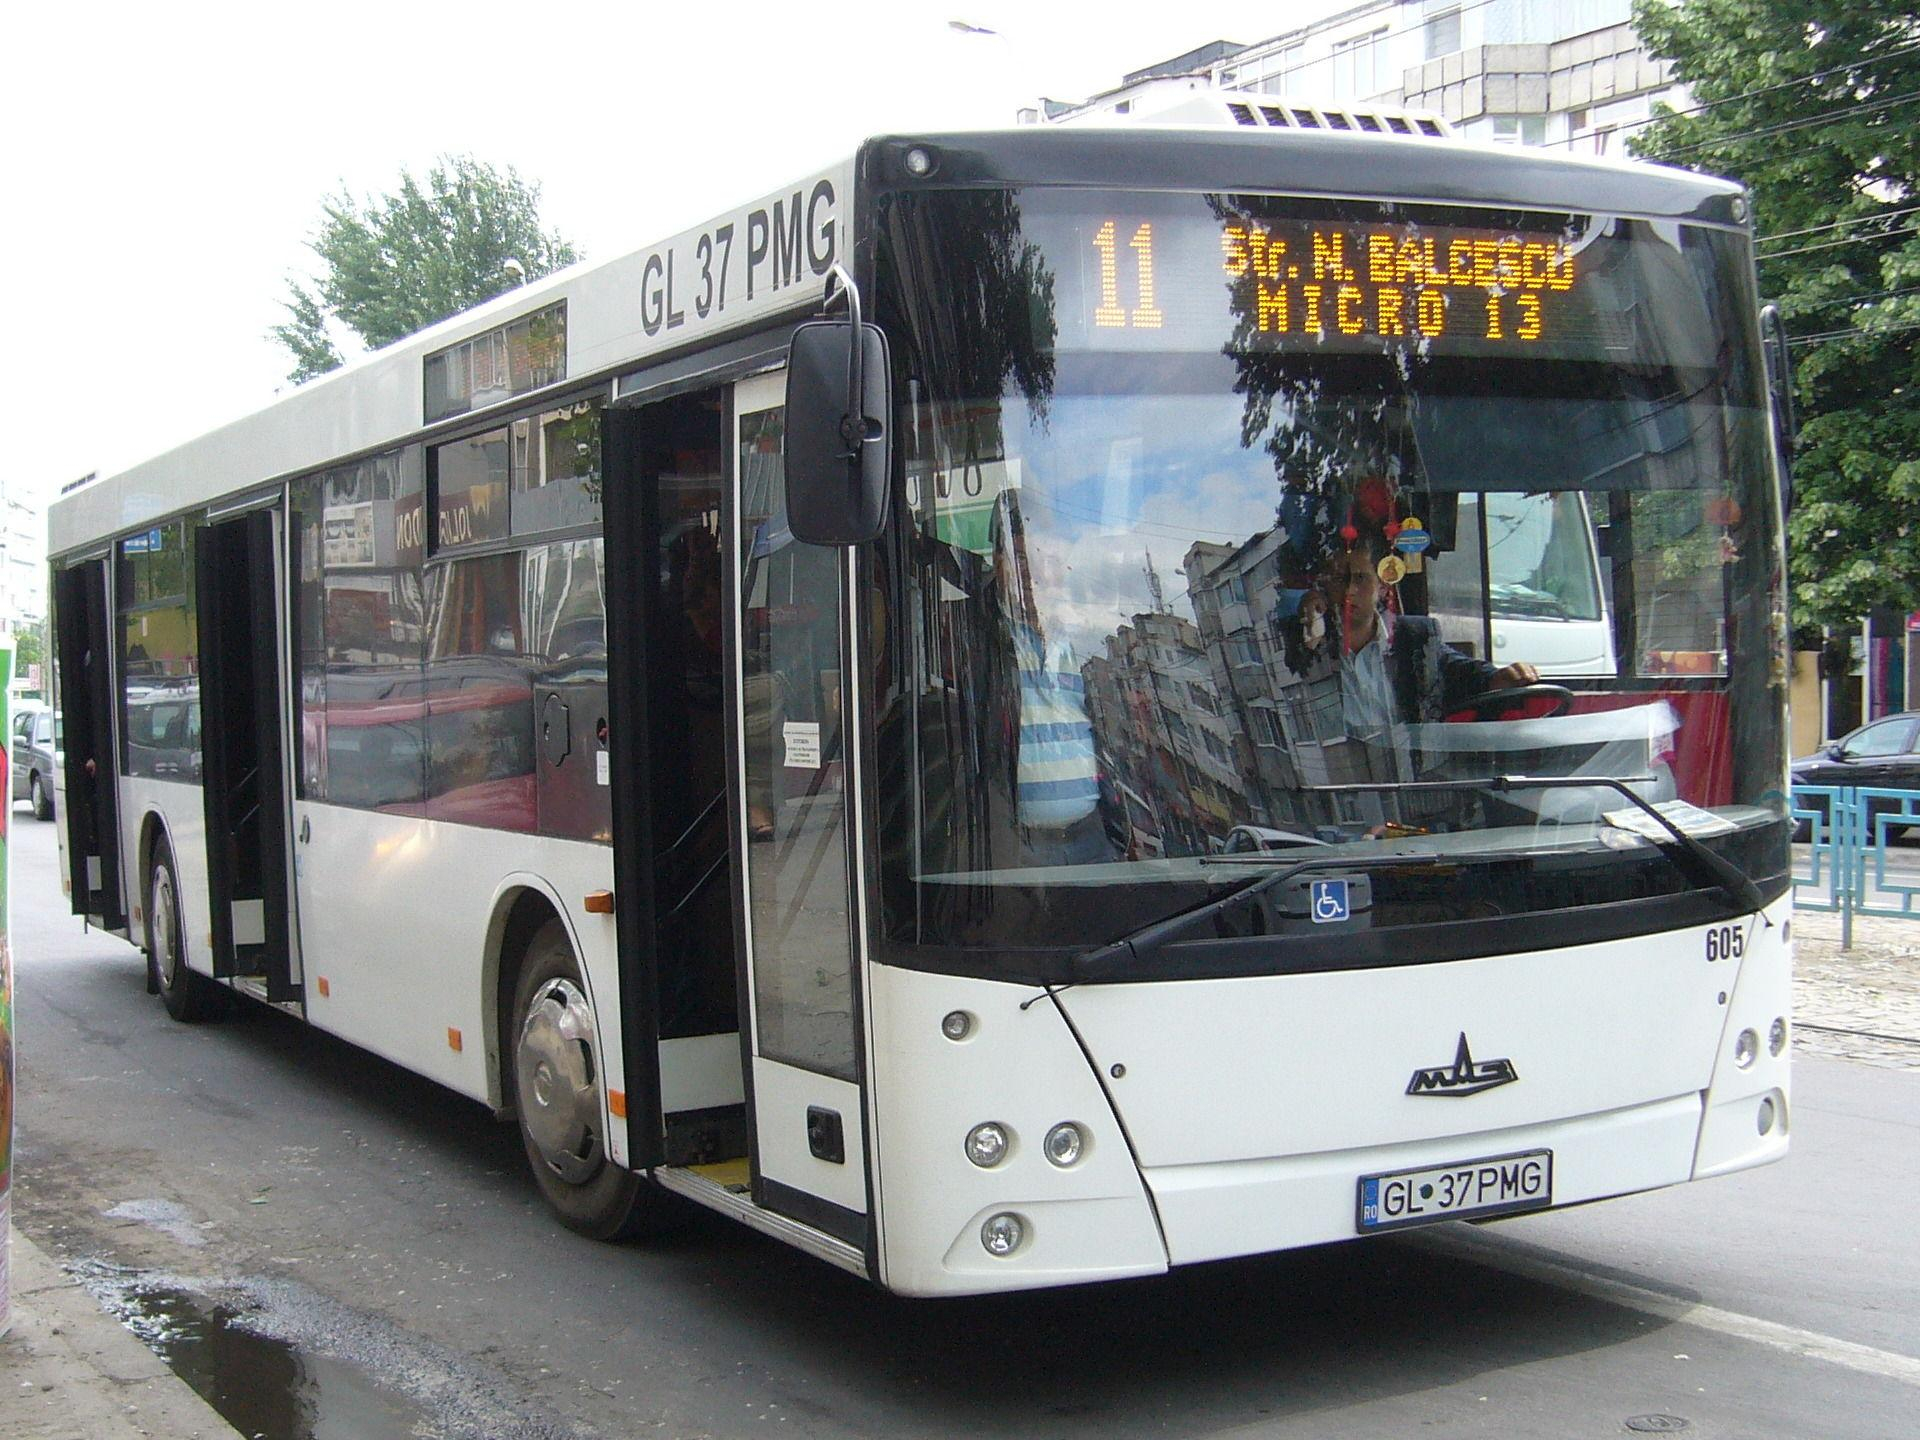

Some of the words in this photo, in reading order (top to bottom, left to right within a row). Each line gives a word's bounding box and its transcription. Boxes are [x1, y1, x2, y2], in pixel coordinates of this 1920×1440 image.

[641, 248, 684, 337] GL
[695, 223, 734, 319] 37
[747, 179, 835, 301] PMG
[1092, 221, 1162, 328] 11
[1221, 226, 1299, 280] Str.
[1313, 231, 1355, 281] N.
[1369, 234, 1574, 291] BALCESCU
[1258, 283, 1444, 337] MICRO
[1485, 293, 1541, 340] 13
[1706, 925, 1743, 962] 605
[1364, 1205, 1377, 1220] RO
